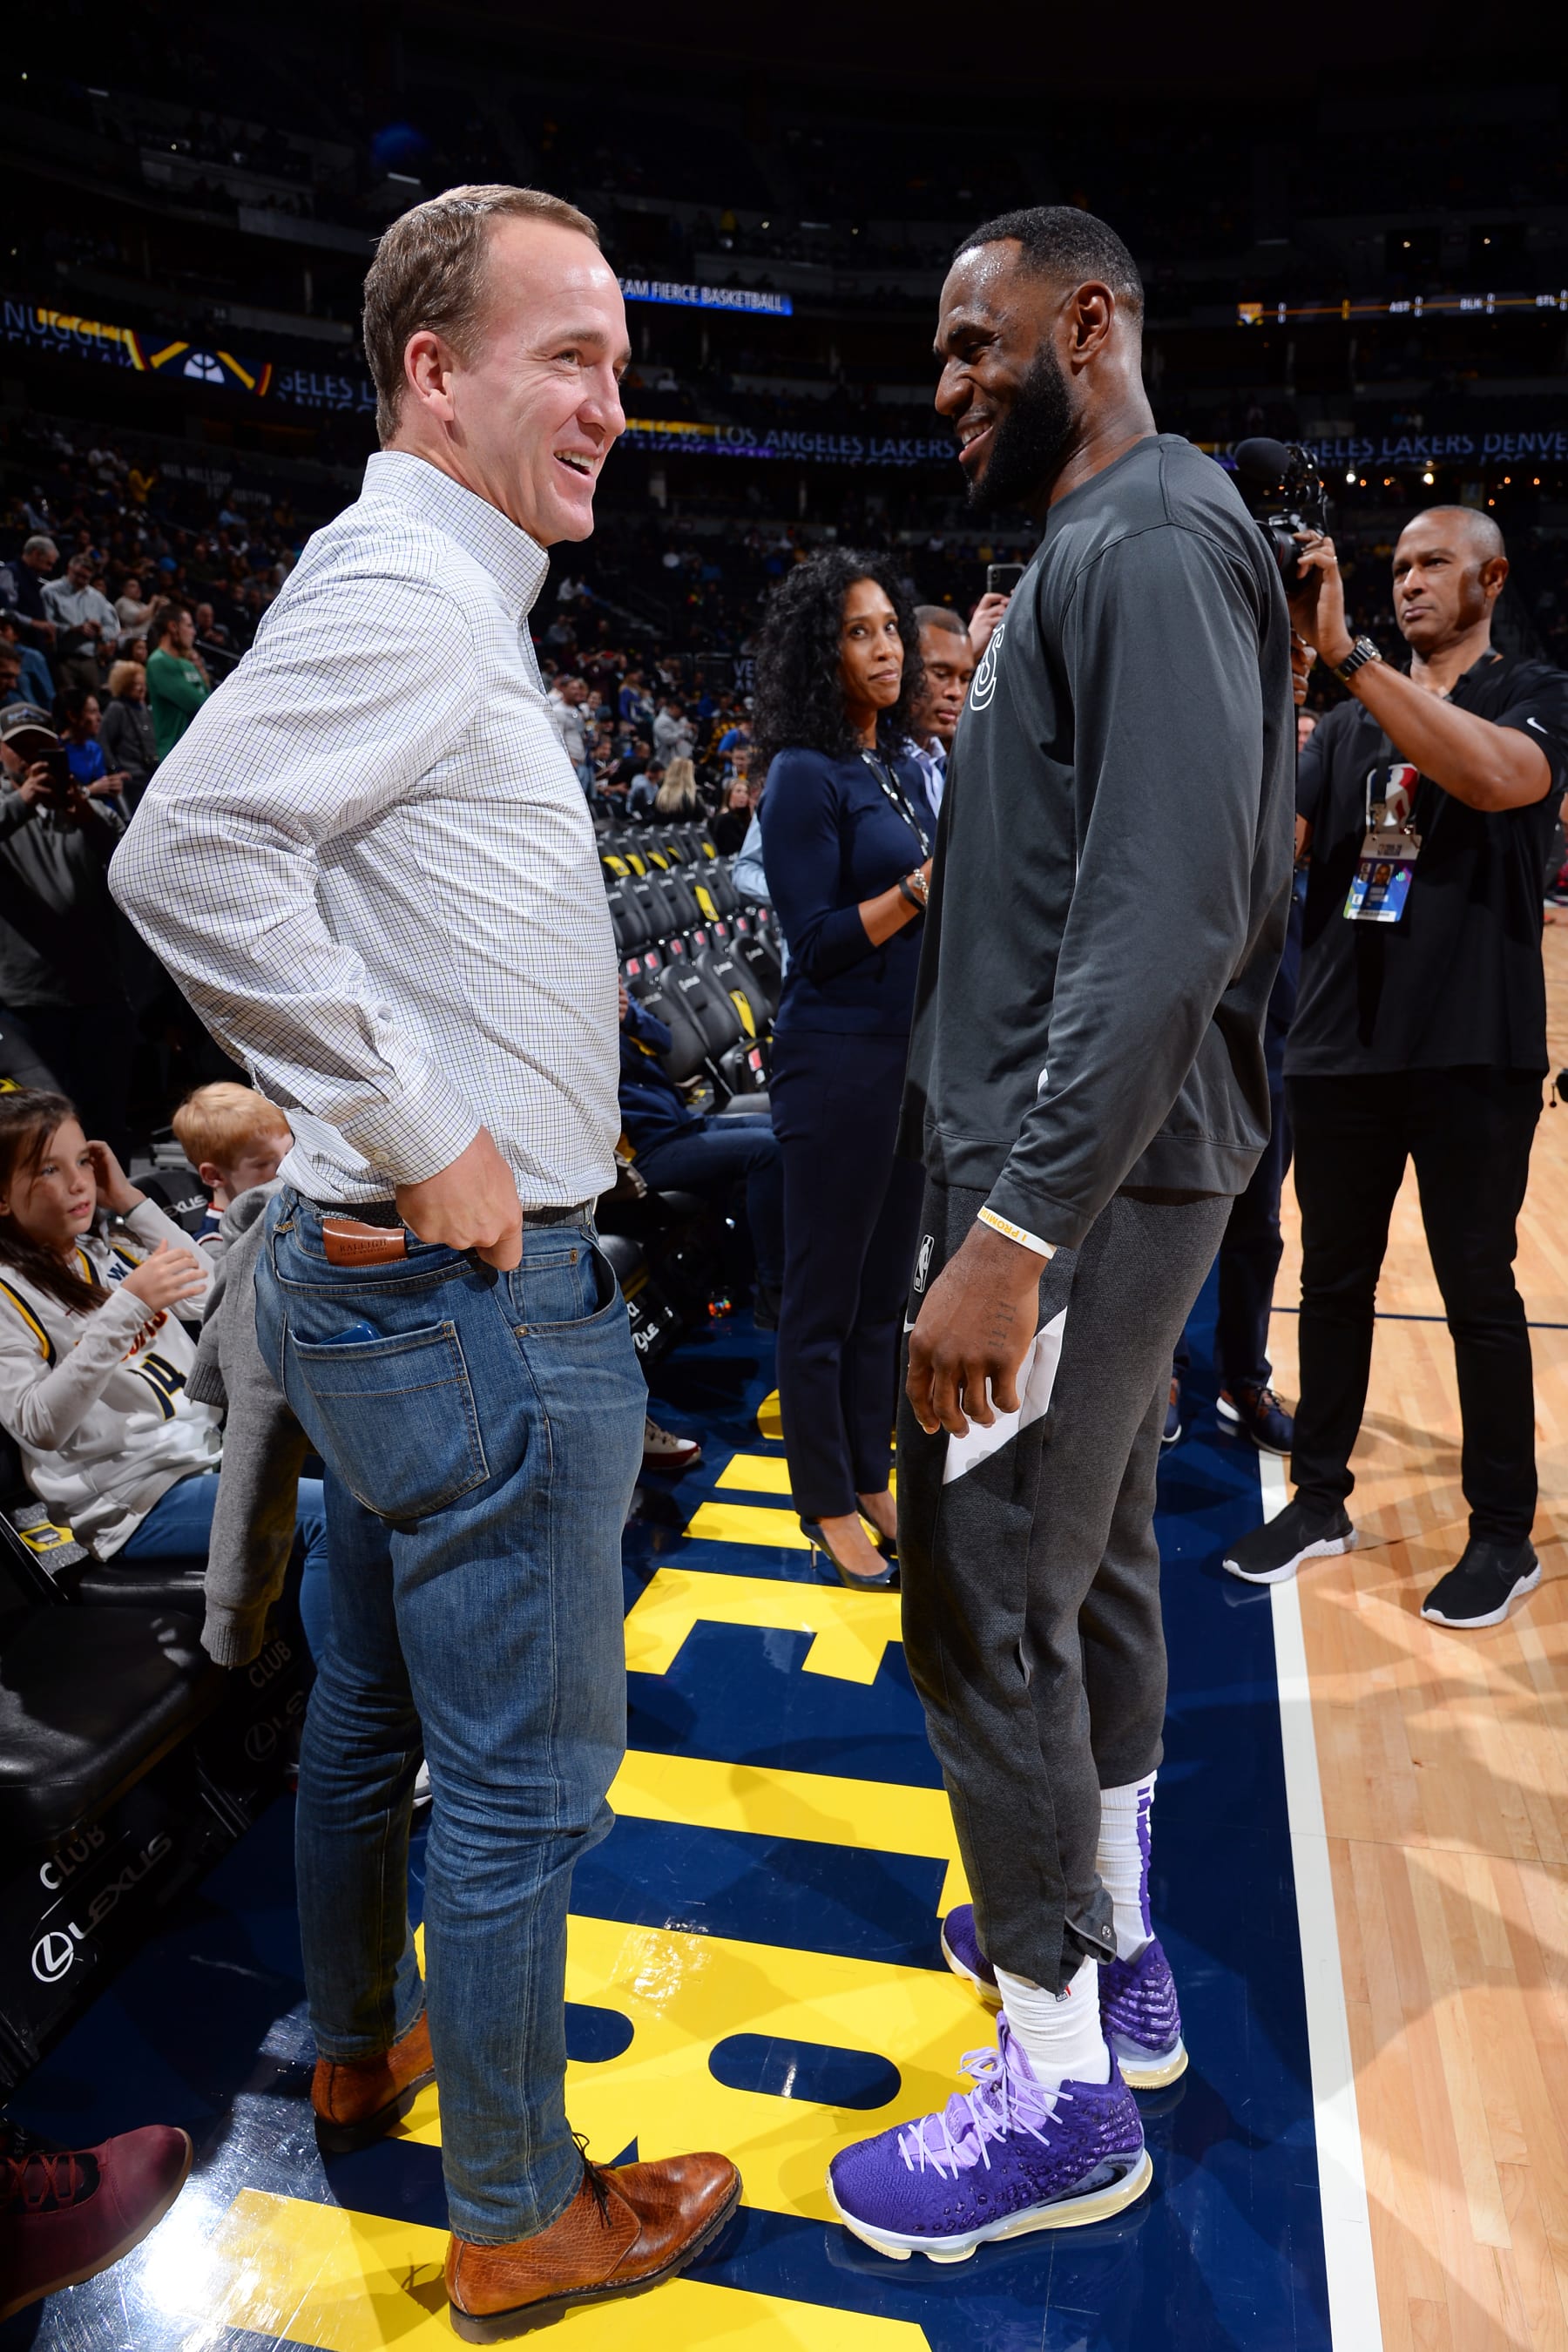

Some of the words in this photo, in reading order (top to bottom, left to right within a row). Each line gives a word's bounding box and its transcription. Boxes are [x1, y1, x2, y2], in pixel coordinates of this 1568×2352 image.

[653, 280, 698, 303] FIERCE
[700, 286, 783, 312] BASKETBALL
[714, 424, 758, 447] LOS
[765, 429, 864, 456] ANGELES
[870, 436, 956, 460] LAKERS
[1382, 434, 1475, 457] LAKERS
[248, 1640, 292, 1688] CLUB
[67, 1829, 173, 1940] LEXUS
